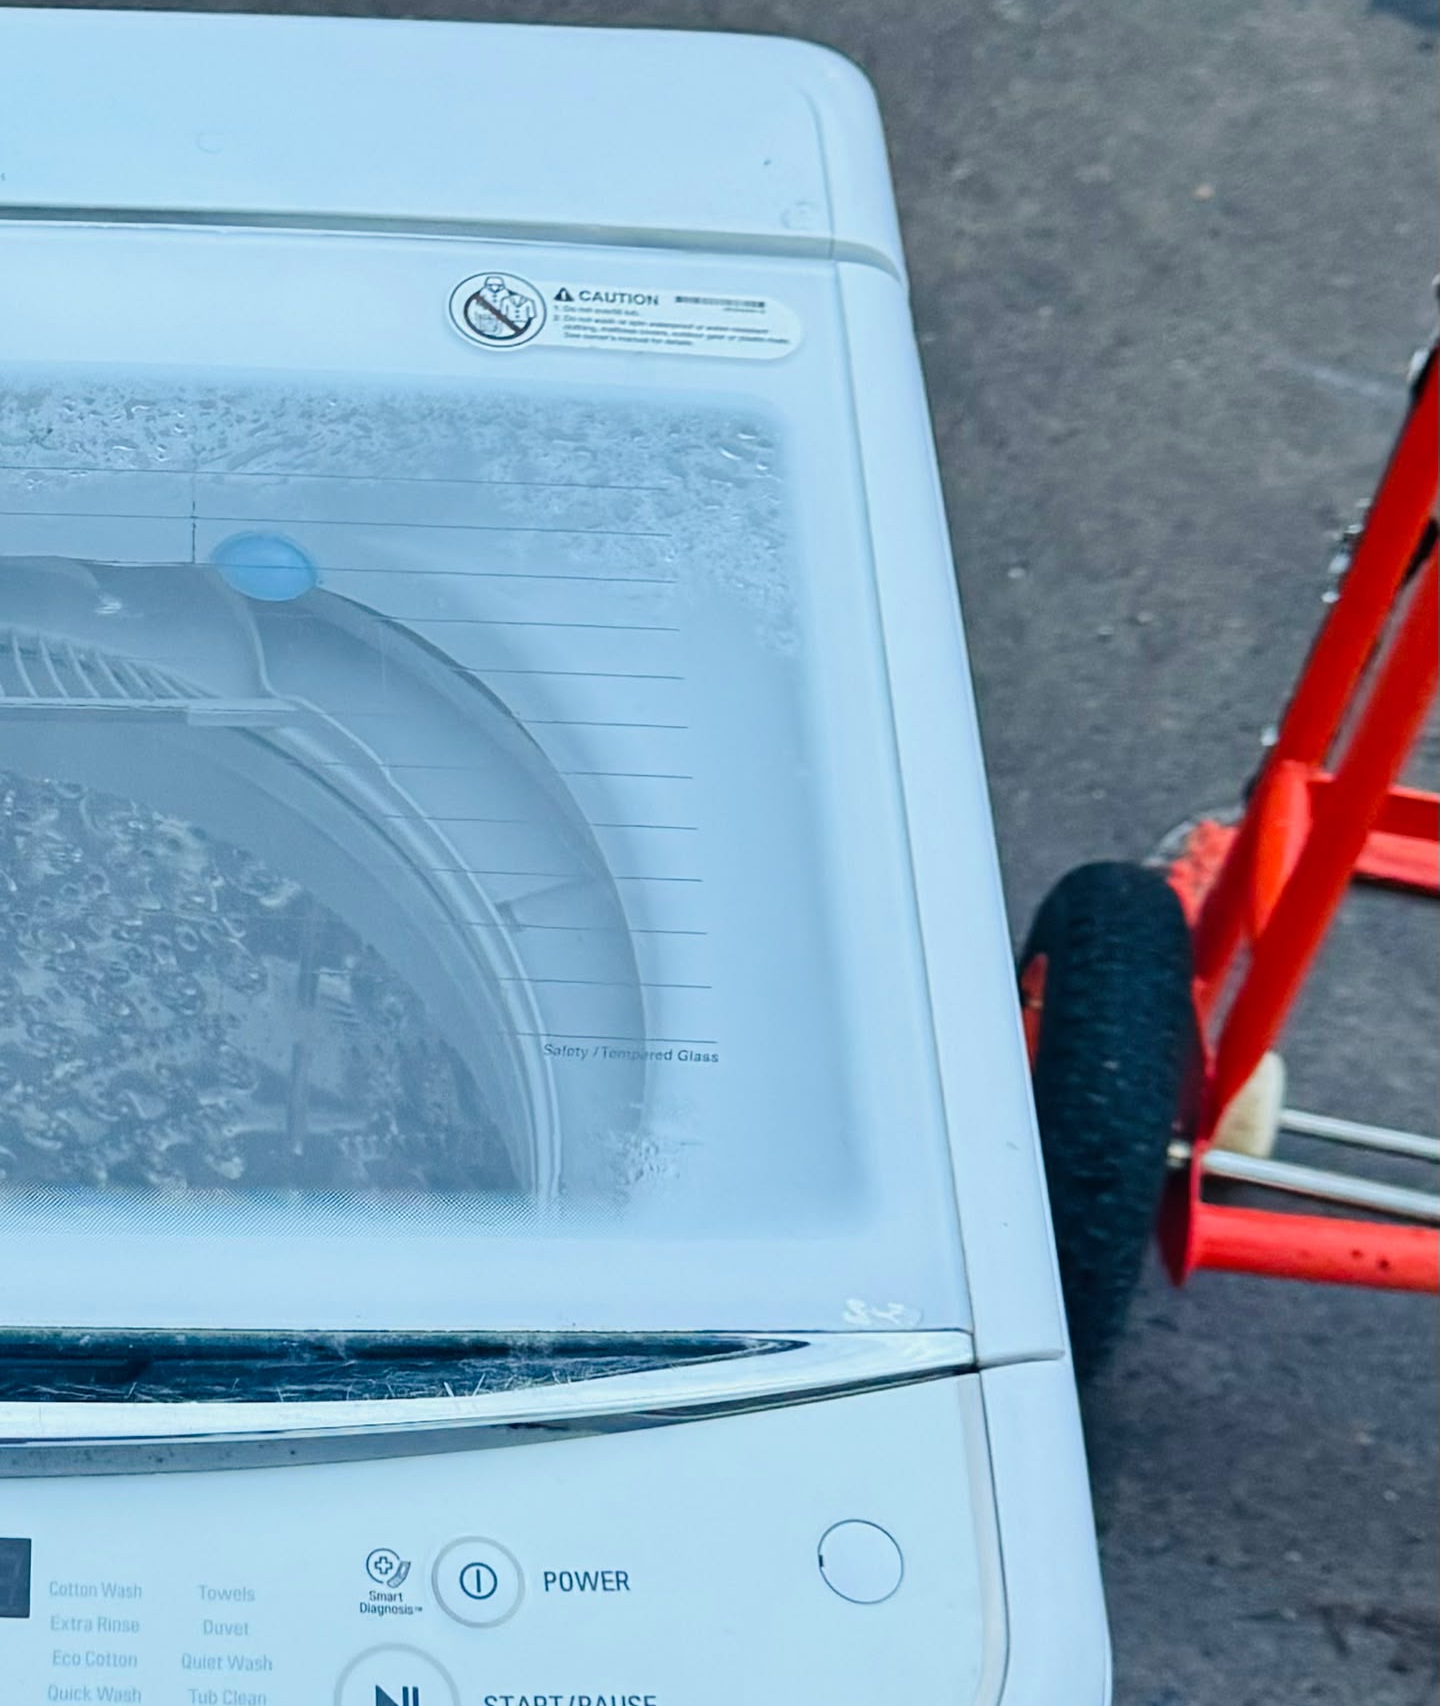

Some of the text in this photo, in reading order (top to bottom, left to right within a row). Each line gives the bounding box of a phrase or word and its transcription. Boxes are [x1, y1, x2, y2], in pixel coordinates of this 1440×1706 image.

[578, 290, 659, 306] CAUTION
[677, 1049, 719, 1063] Glass
[543, 1570, 631, 1592] POWER
[49, 1581, 143, 1600] Cotton Wash
[197, 1584, 256, 1602] Towels
[368, 1590, 403, 1603] Smart
[50, 1615, 140, 1634] Extra Rinse
[202, 1619, 249, 1636] Duvet
[52, 1650, 138, 1668] Eco Cotton
[181, 1653, 273, 1672] Quiet Wash
[48, 1685, 142, 1704] Quick Wash
[189, 1688, 267, 1706] Tub Clean
